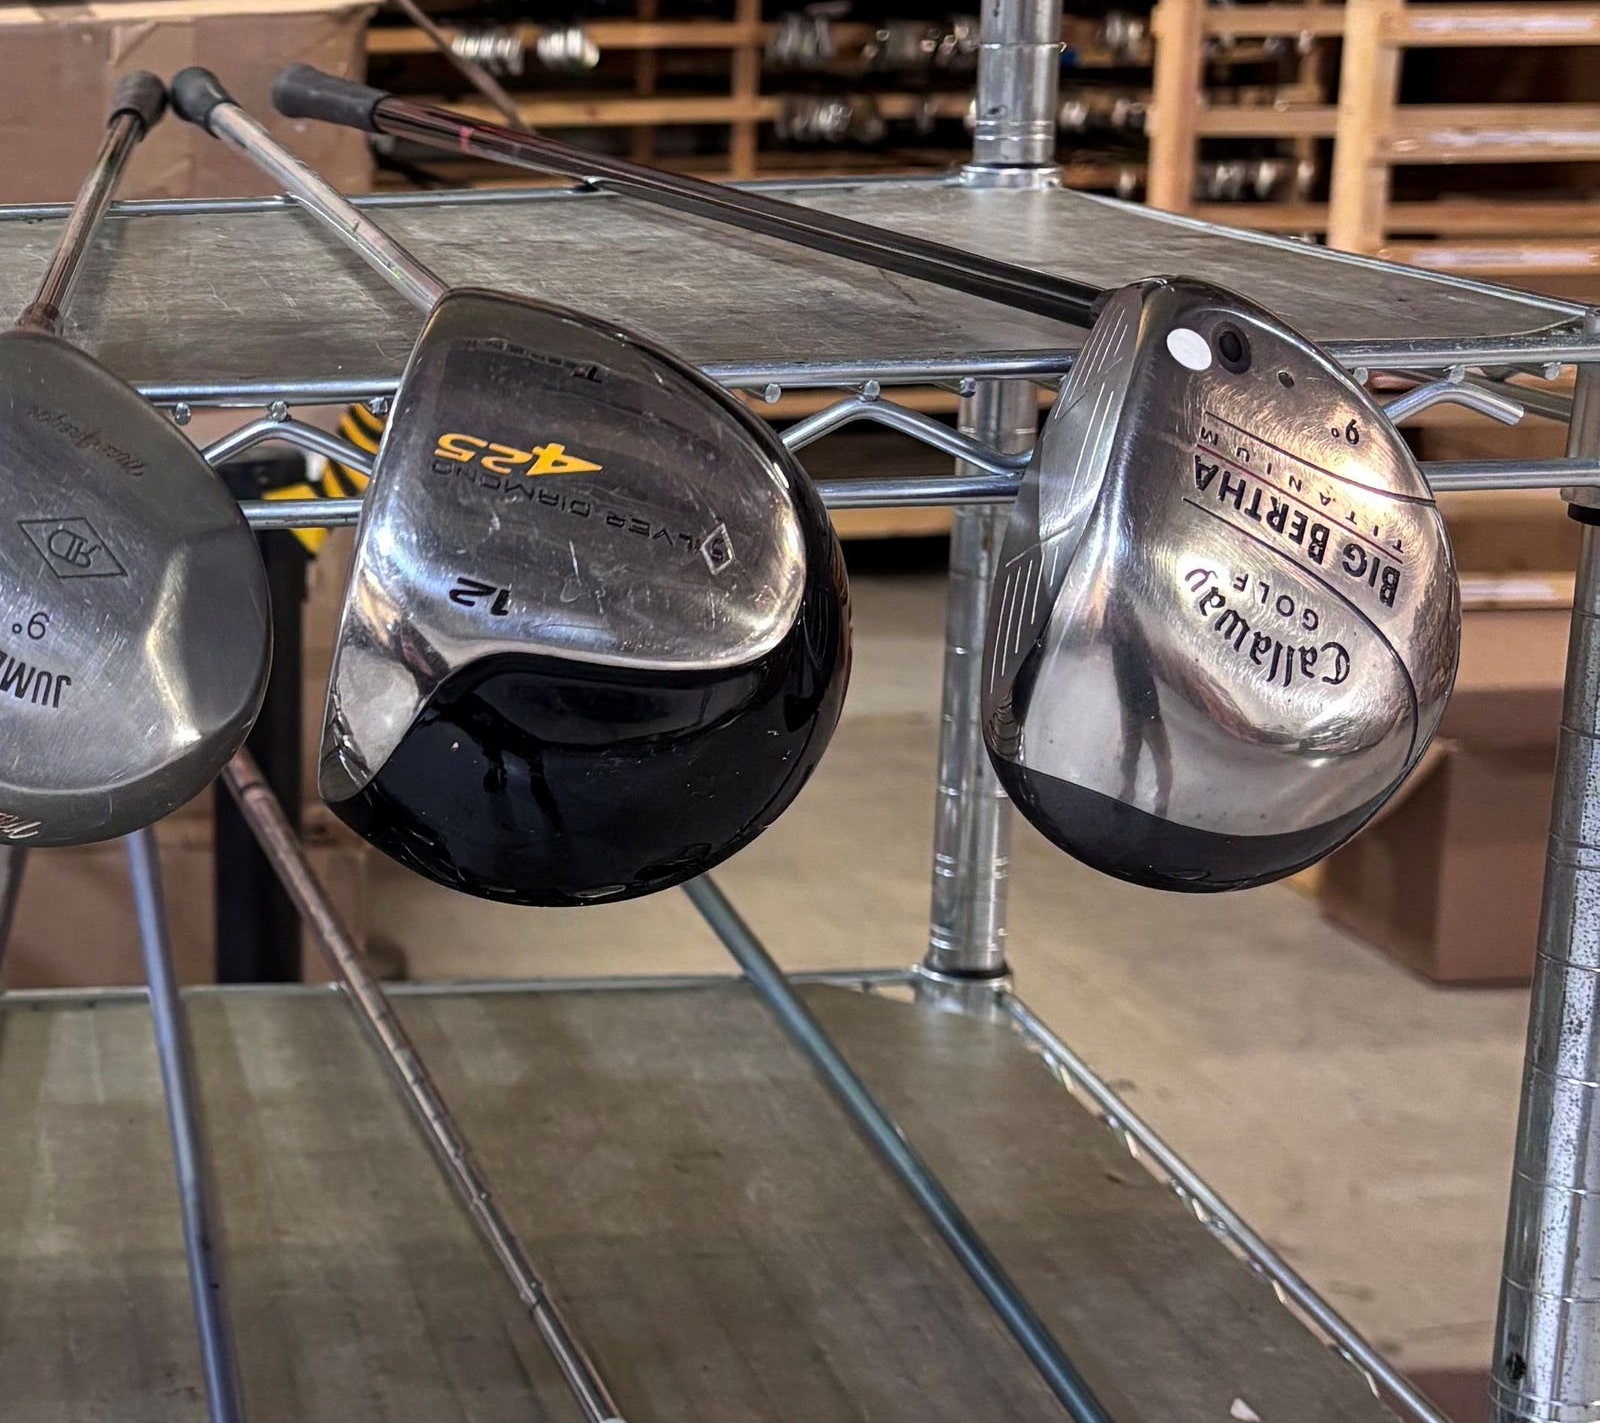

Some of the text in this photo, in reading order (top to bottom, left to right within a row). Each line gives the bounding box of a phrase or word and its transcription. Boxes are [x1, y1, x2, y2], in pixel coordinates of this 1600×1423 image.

[434, 432, 603, 477] 425
[1200, 428, 1405, 554] TITANIUM
[430, 460, 730, 568] SILVER DIAMOND
[1193, 454, 1401, 608] BIG BERTHA
[10, 609, 50, 641] 9°
[448, 577, 511, 617] 12
[1184, 567, 1351, 687] Callaway
[1233, 573, 1320, 631] GOLF
